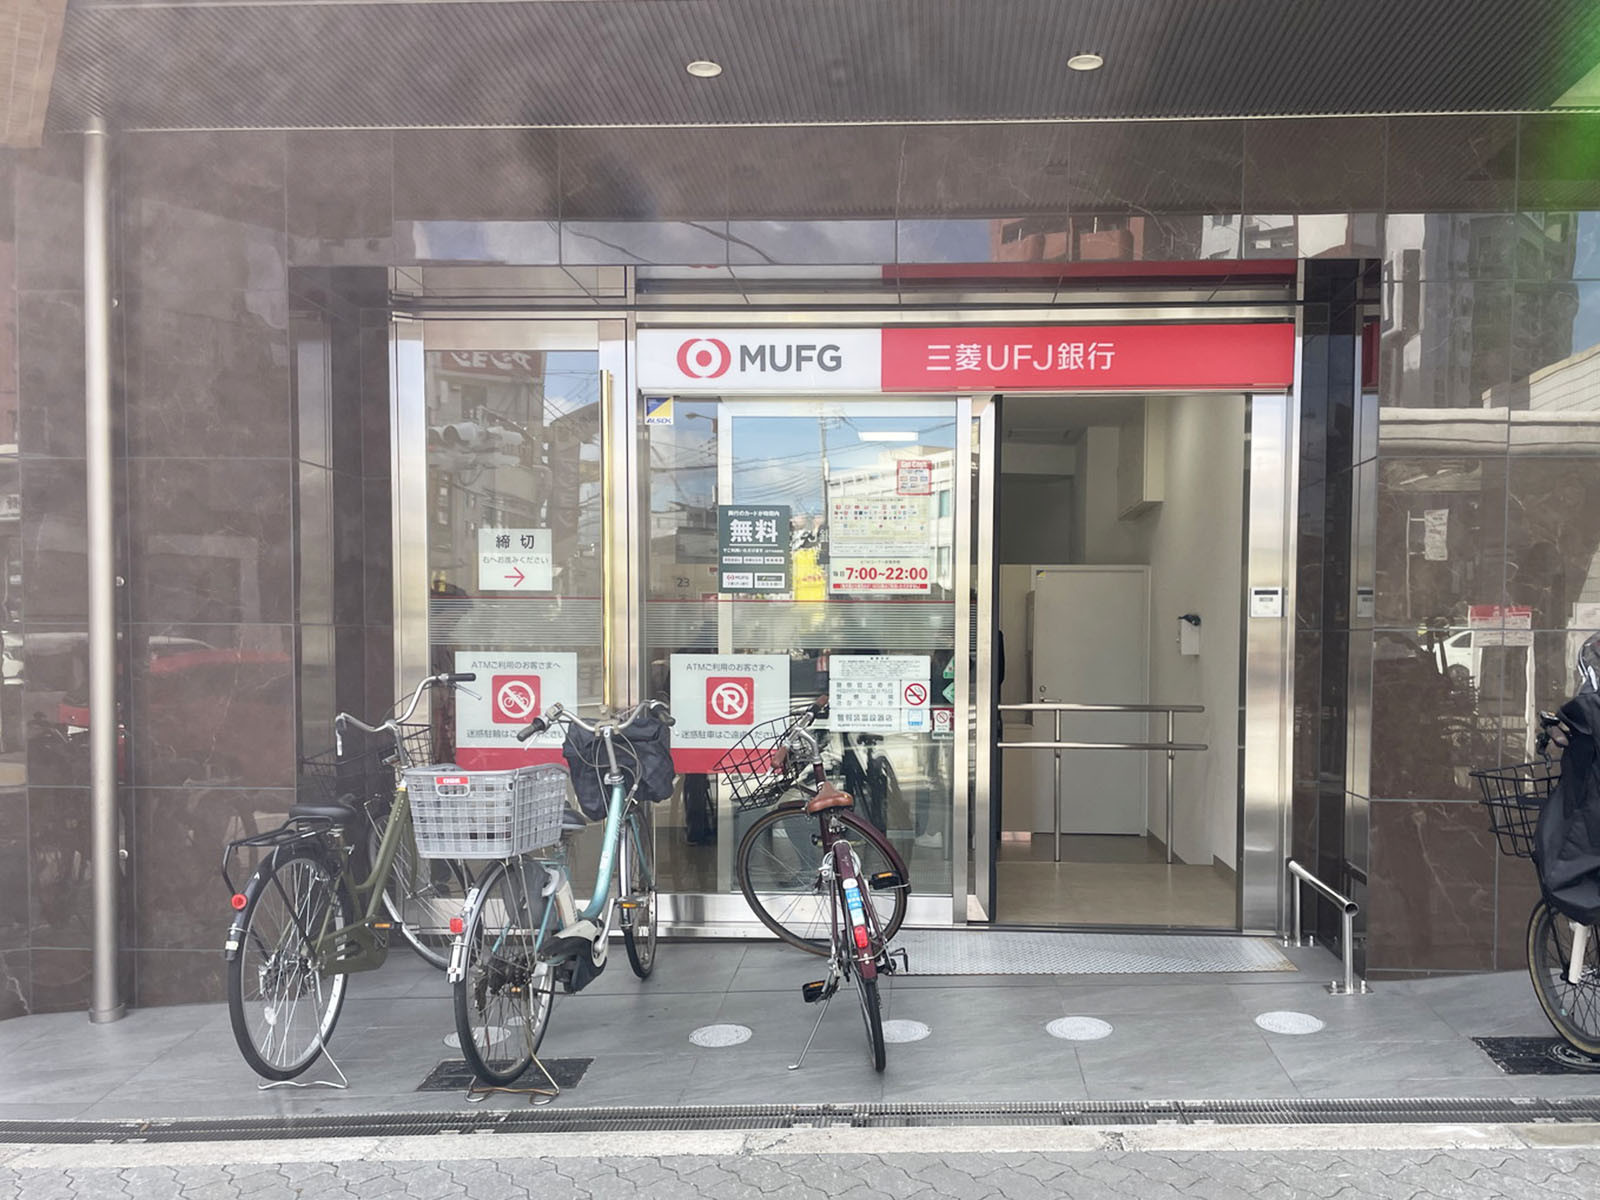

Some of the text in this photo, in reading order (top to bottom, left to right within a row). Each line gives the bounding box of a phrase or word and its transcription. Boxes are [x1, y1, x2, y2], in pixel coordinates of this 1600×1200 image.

[739, 344, 843, 373] MUFG
[926, 341, 1116, 371] 三菱UFJ銀行
[729, 519, 779, 543] 無料
[495, 534, 535, 549] 締切
[676, 577, 690, 587] 23
[471, 661, 561, 670] ATMご利用のお客さまへ
[686, 663, 774, 672] ATMご利用のお客さまへ
